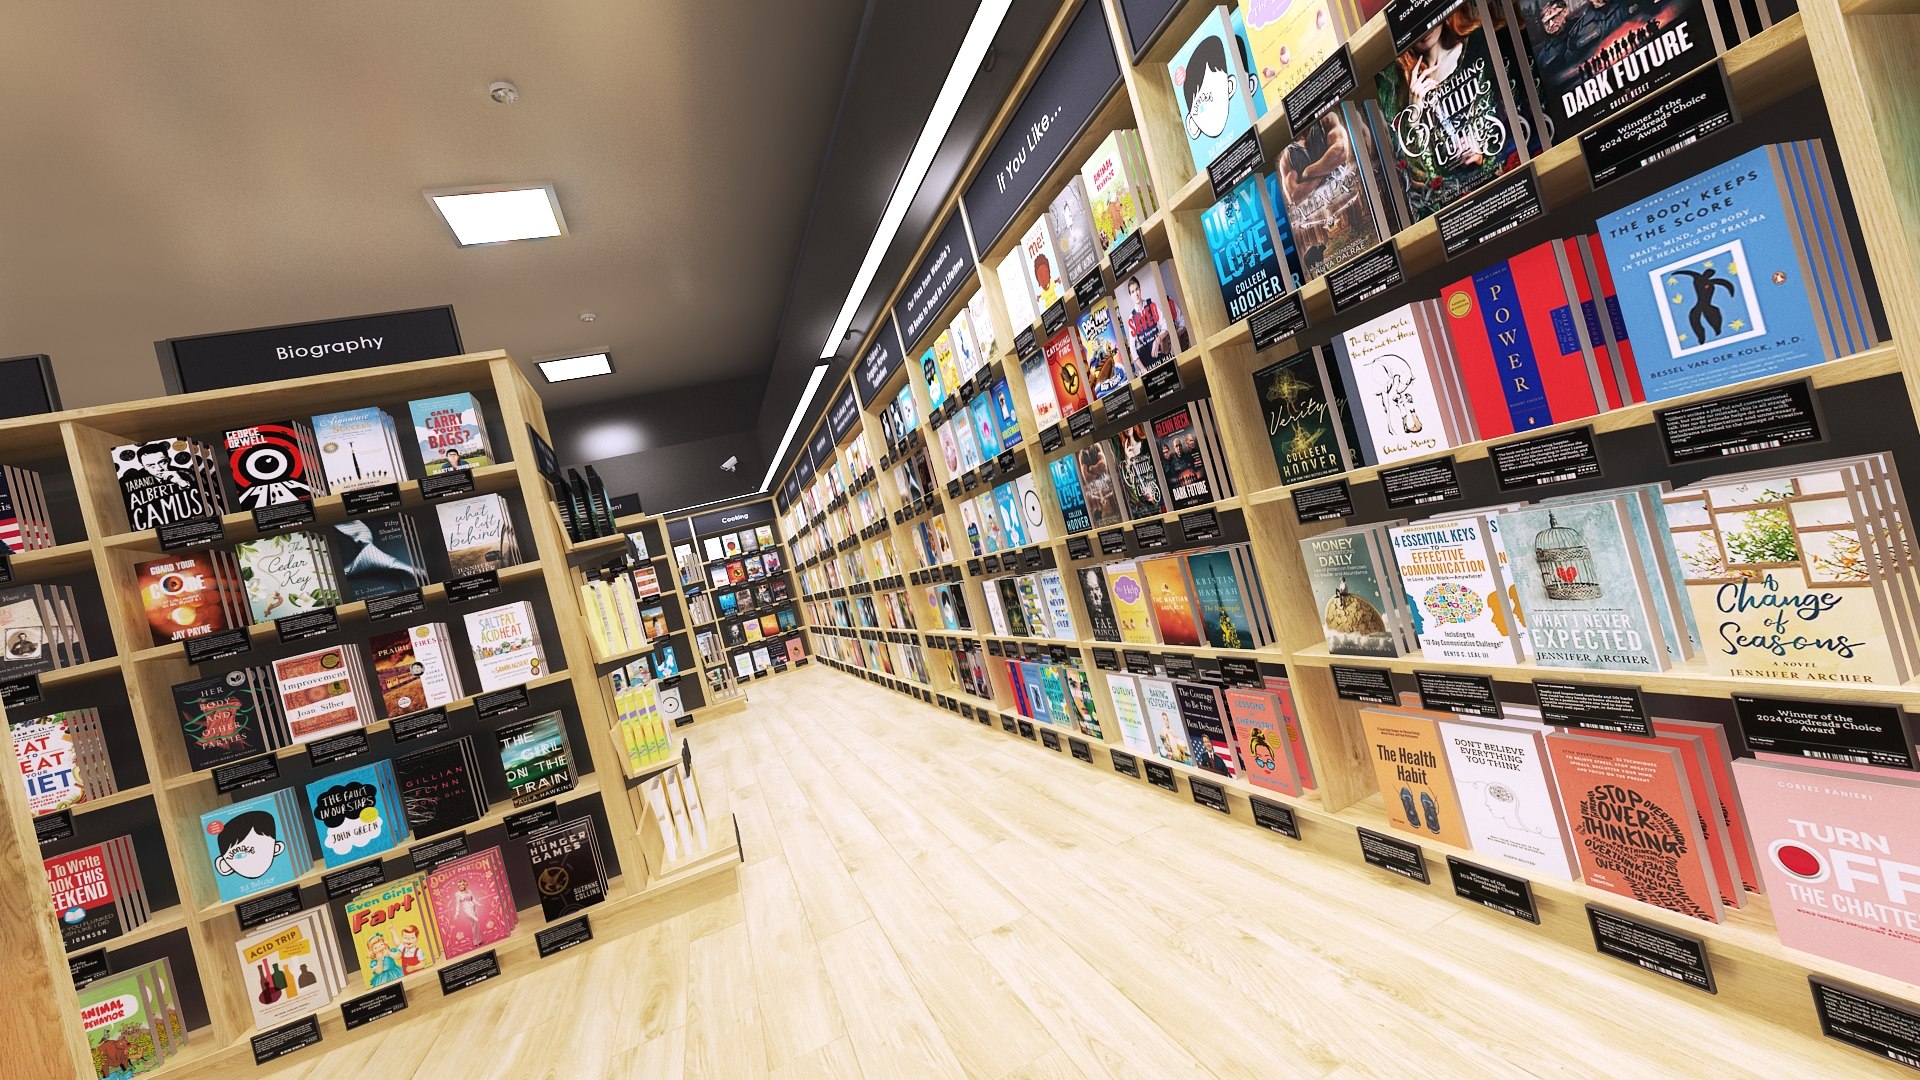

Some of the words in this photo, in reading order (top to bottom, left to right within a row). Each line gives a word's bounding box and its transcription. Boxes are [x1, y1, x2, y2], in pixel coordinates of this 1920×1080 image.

[1277, 48, 1323, 93] KATHRYN
[1561, 70, 1615, 119] DARK
[1615, 21, 1694, 89] FUTURE
[1600, 137, 1622, 152] 2024
[1623, 112, 1672, 140] Goodreads
[1673, 93, 1707, 114] Choice
[1617, 113, 1653, 135] Winner
[1653, 105, 1665, 116] of
[1665, 97, 1682, 110] the
[1637, 121, 1668, 140] Award
[996, 172, 1006, 194] If
[1006, 147, 1026, 179] You
[1027, 106, 1062, 152] Like...
[1204, 179, 1263, 251] UGLY
[1610, 221, 1639, 239] THE
[1646, 199, 1691, 223] BODY
[1700, 170, 1759, 202] KEEPS
[1635, 224, 1667, 242] THE
[1675, 196, 1734, 227] SCORE
[1630, 244, 1662, 260] BRAIN,
[1663, 232, 1694, 246] MIND,
[1696, 222, 1717, 234] AND
[1721, 209, 1751, 225] BODY
[1028, 232, 1045, 259] me!
[1214, 222, 1274, 286] LOVE
[927, 290, 938, 310] Read
[945, 258, 963, 286] Lifetime
[1235, 268, 1267, 294] COLLEEN
[1230, 276, 1281, 318] HOOVER
[1128, 302, 1159, 337] SAVED
[276, 335, 384, 361] Biography
[1046, 335, 1070, 357] CATCHING
[1490, 284, 1530, 393] POWER
[1058, 344, 1071, 357] FIRE
[1650, 367, 1684, 379] BESSEL
[1687, 359, 1709, 370] VAN
[1713, 353, 1734, 364] DER
[1738, 343, 1772, 358] KOLK,
[425, 413, 462, 430] CARRY
[1155, 418, 1173, 438] GLENN
[1173, 410, 1189, 430] BECK
[1269, 397, 1328, 436] Verity
[226, 427, 260, 440] GEORGE
[428, 430, 471, 449] BAGS?
[433, 425, 461, 434] YOUR
[228, 435, 267, 449] ORWELL
[1286, 445, 1328, 464] COLLEEN
[1050, 458, 1079, 488] UGLY
[1283, 455, 1337, 477] HOOVER
[131, 483, 175, 510] ALBERT
[1056, 481, 1084, 510] LOVE
[1173, 488, 1187, 501] DARK
[1187, 481, 1208, 498] FUTURE
[133, 488, 203, 531] CAMUS
[721, 512, 749, 524] Cooking
[1066, 516, 1090, 531] HOOVER
[450, 519, 501, 550] behind
[1312, 538, 1353, 552] MONEY
[1394, 537, 1400, 547] 4
[1402, 531, 1449, 547] ESSENTIAL
[1452, 527, 1476, 542] KEYS
[267, 557, 308, 574] Cedar
[1319, 554, 1353, 567] DAILY
[1411, 549, 1466, 563] EFFECTIVE
[150, 562, 174, 575] GUARD
[176, 560, 195, 570] YOUR
[1401, 560, 1486, 577] COMMUNICATION
[280, 570, 312, 590] Key
[1124, 585, 1140, 596] Help
[1195, 576, 1235, 586] KRISTIN
[1050, 598, 1065, 606] NEVER
[1199, 588, 1238, 597] HANNAH
[1716, 578, 1843, 621] Change
[1094, 628, 1120, 636] PRINCES
[1095, 617, 1112, 629] FAE
[1531, 614, 1568, 628] WHAT
[1573, 615, 1579, 628] I
[1583, 614, 1632, 630] NEVER
[1764, 609, 1789, 634] of
[171, 630, 186, 641] JAY
[187, 625, 212, 638] PAYNE
[1531, 629, 1643, 651] EXPECTED
[1719, 622, 1866, 659] Seasons
[378, 643, 412, 657] PRAIRIE
[414, 637, 437, 648] FIRES
[1536, 651, 1591, 663] JENNIFER
[1595, 654, 1650, 665] ARCHER
[283, 670, 347, 691] Improvement
[1730, 669, 1799, 679] JENNIFER
[1807, 672, 1874, 683] ARCHER
[201, 686, 224, 698] HER
[1112, 685, 1135, 697] OUTLIVE
[1178, 687, 1189, 697] The
[1189, 689, 1214, 704] Courage
[297, 707, 316, 719] Joan
[320, 700, 345, 712] Silber
[1777, 709, 1818, 720] Winner
[1820, 713, 1832, 721] of
[1833, 715, 1853, 723] the
[1757, 714, 1782, 723] 2024
[1784, 717, 1841, 729] Goodreads
[1842, 722, 1882, 732] Choice
[1800, 726, 1836, 735] Award
[501, 731, 536, 749] THE
[520, 741, 562, 760] GIRL
[1454, 738, 1482, 749] DON'T
[1484, 743, 1525, 756] BELIEVE
[20, 752, 65, 774] EAT
[1377, 744, 1397, 762] The
[1399, 748, 1437, 768] Health
[1460, 747, 1523, 764] EVERYTHING
[1466, 756, 1486, 765] YOU
[1486, 759, 1521, 772] THINK
[25, 770, 48, 778] YOUR
[405, 766, 463, 788] GILLIAN
[505, 765, 529, 781] ON
[534, 755, 568, 771] THE
[1397, 765, 1428, 785] Habit
[415, 779, 459, 796] FLYNN
[512, 771, 568, 796] TRAIN
[322, 793, 342, 806] THE
[344, 786, 368, 800] FAULT
[1595, 785, 1643, 808] STOP
[1599, 803, 1655, 831] OVER
[530, 831, 586, 856] HUNGER
[1582, 816, 1681, 858] THINKING
[1787, 817, 1891, 855] TURN
[532, 842, 581, 864] GAMES
[54, 864, 67, 877] To
[67, 854, 101, 873] Write
[1767, 838, 1920, 905] OFF
[347, 896, 380, 913] Even
[382, 886, 413, 901] Girls
[352, 894, 415, 934] Fart
[250, 940, 274, 958] ACID
[274, 931, 297, 948] TRIP
[81, 998, 124, 1019] ANIMAL
[84, 1009, 125, 1030] BEHAVIOR
